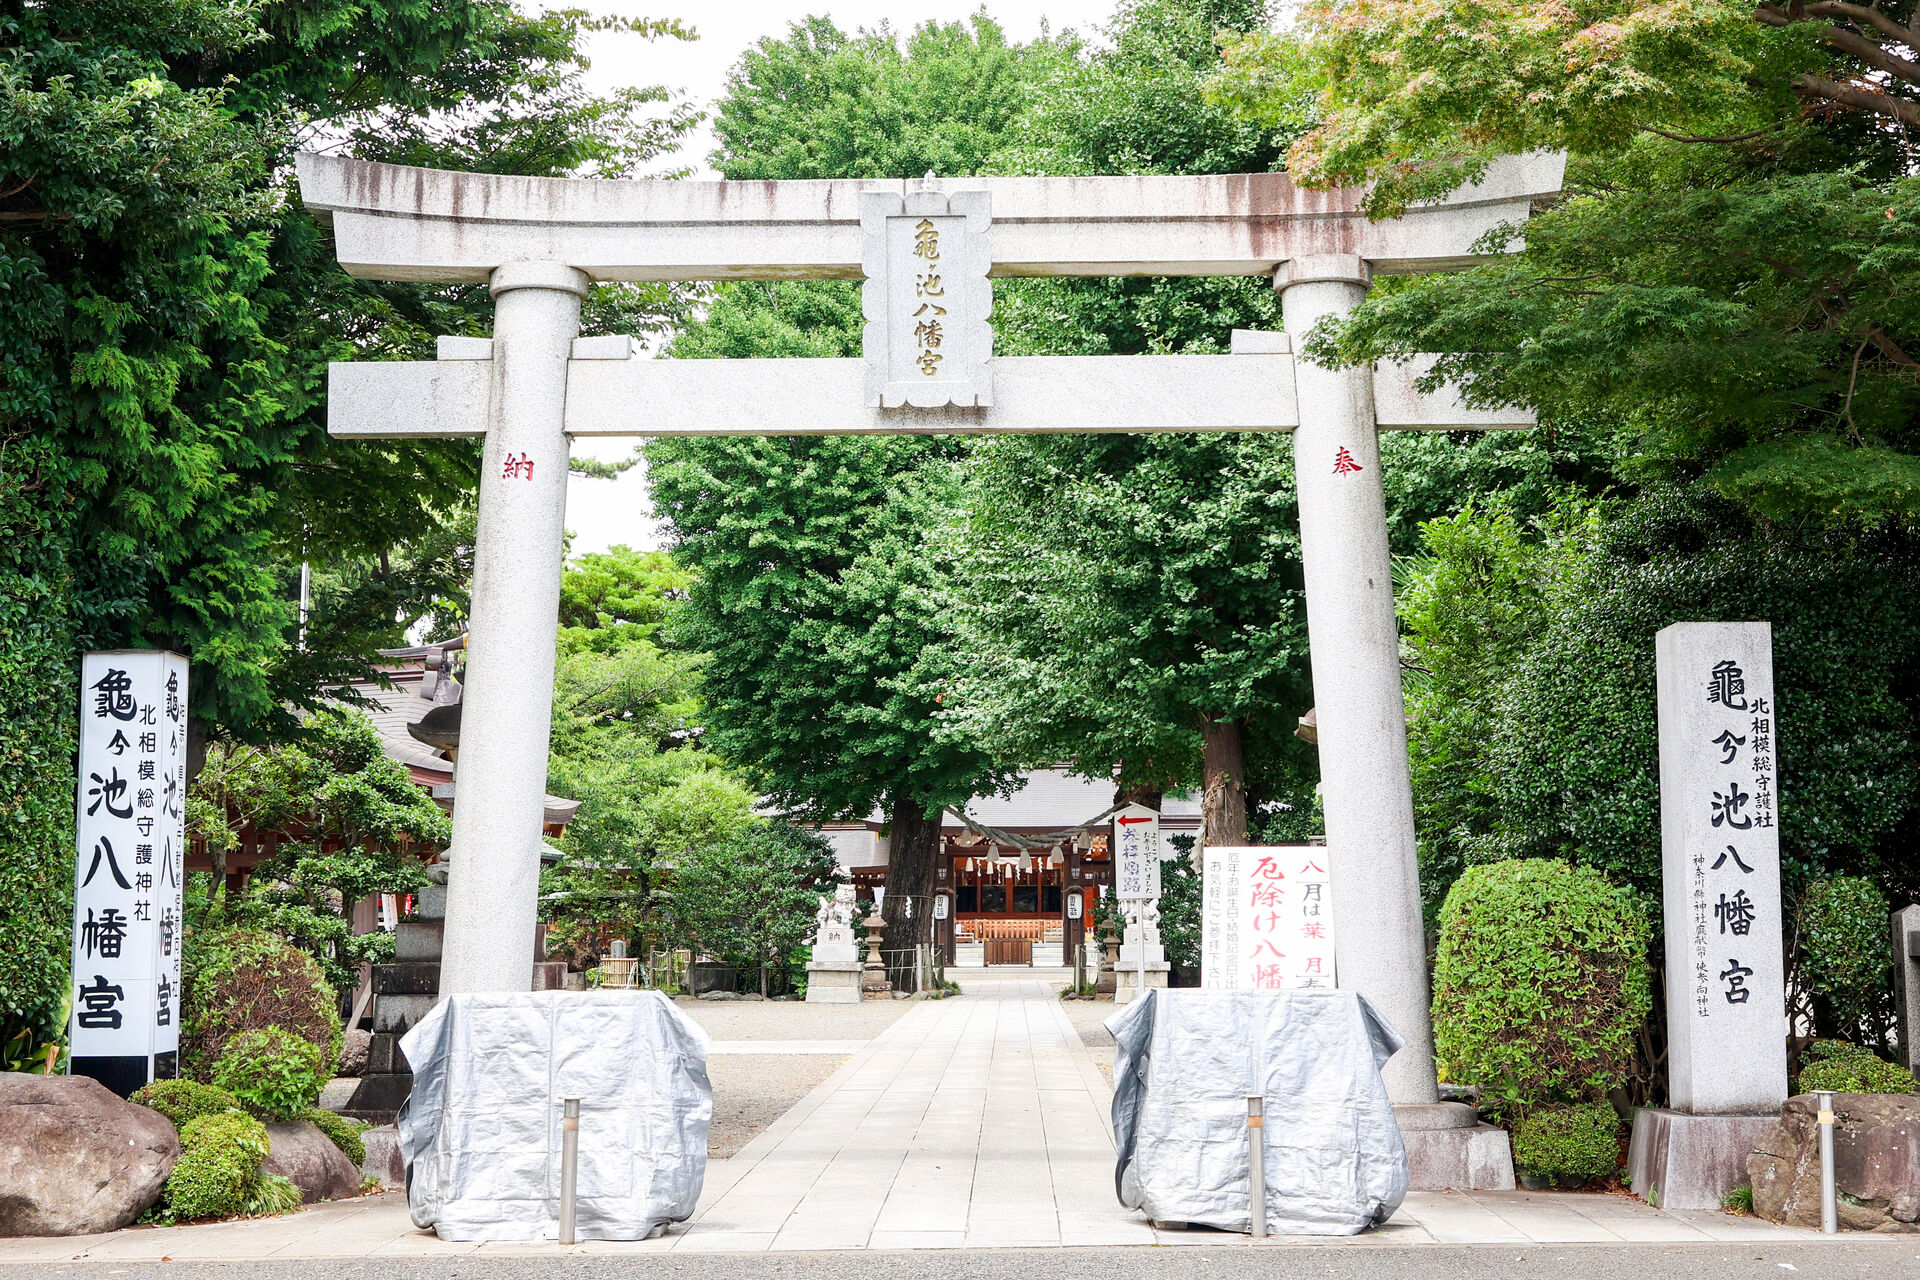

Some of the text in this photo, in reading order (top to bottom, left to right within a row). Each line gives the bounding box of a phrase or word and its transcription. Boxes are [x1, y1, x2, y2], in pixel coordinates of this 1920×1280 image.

[502, 452, 534, 481] 納
[1332, 446, 1363, 478] 奉
[133, 704, 157, 921] 北相模総守護神社
[1749, 697, 1774, 828] 北相模総守護社
[1249, 856, 1286, 989] 厄除け八幡
